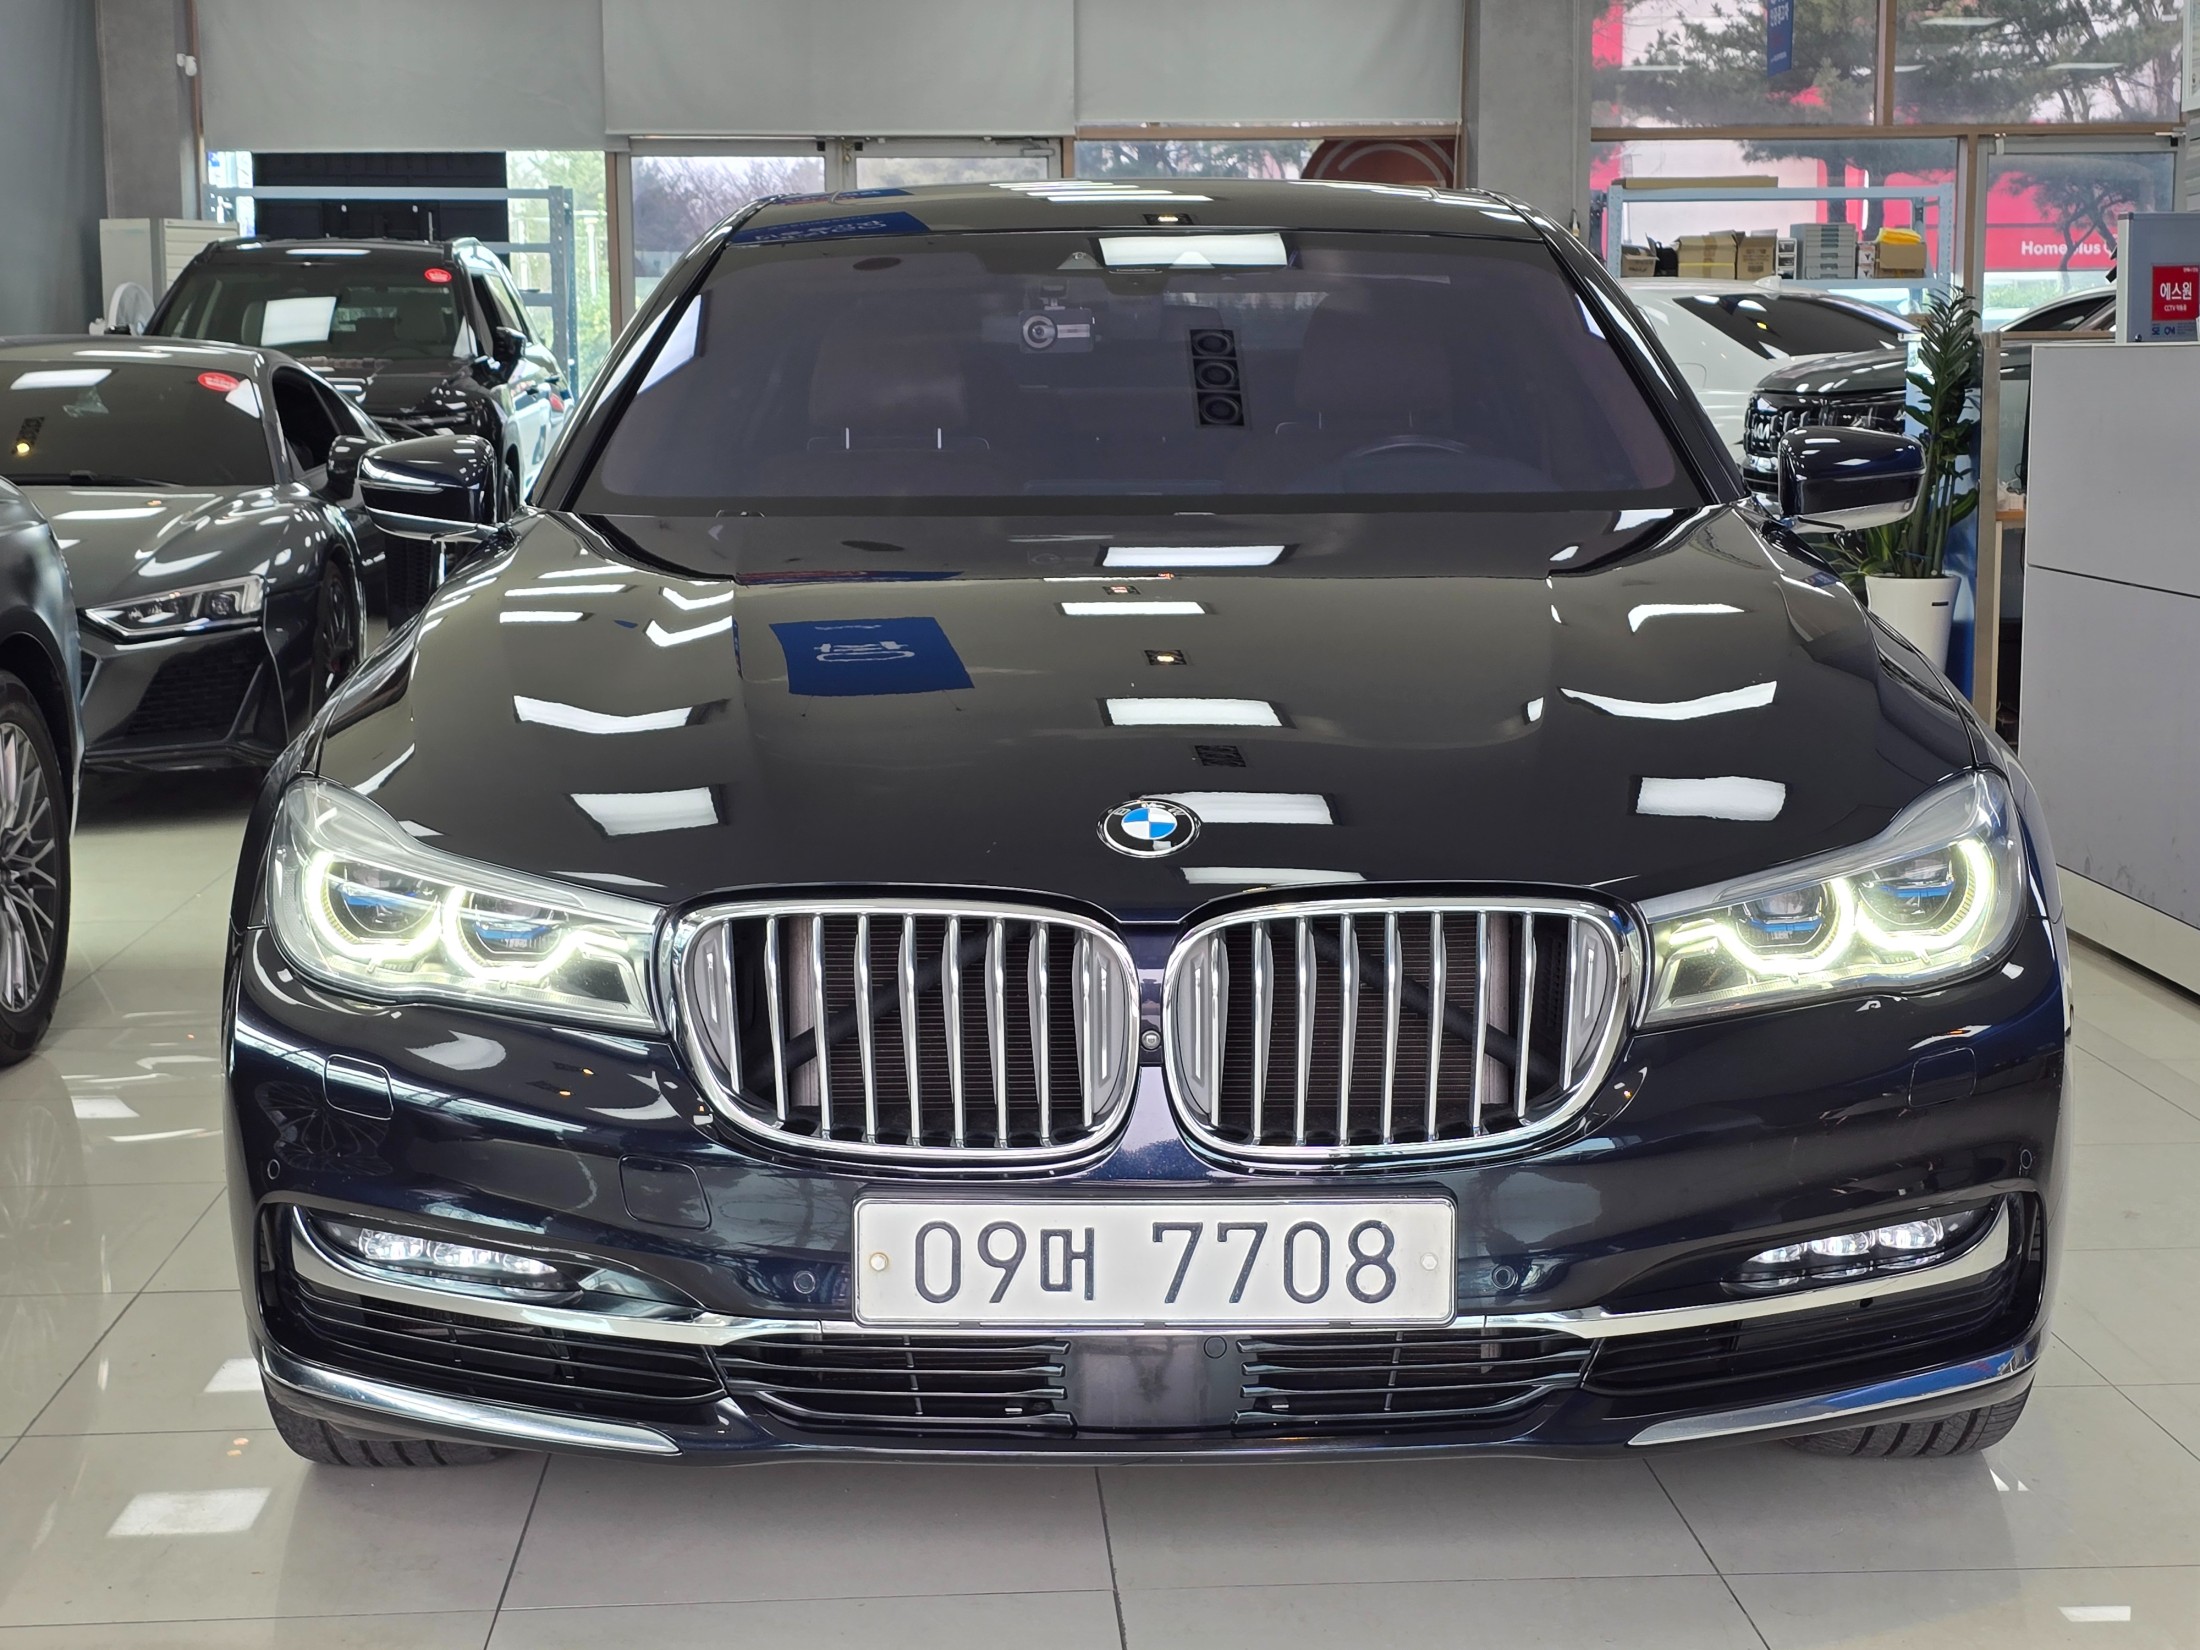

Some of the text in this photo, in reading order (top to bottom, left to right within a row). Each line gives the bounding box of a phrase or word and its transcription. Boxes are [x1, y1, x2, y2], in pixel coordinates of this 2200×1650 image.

[2160, 282, 2192, 300] 에스원
[914, 1220, 1398, 1304] 09머 7708
